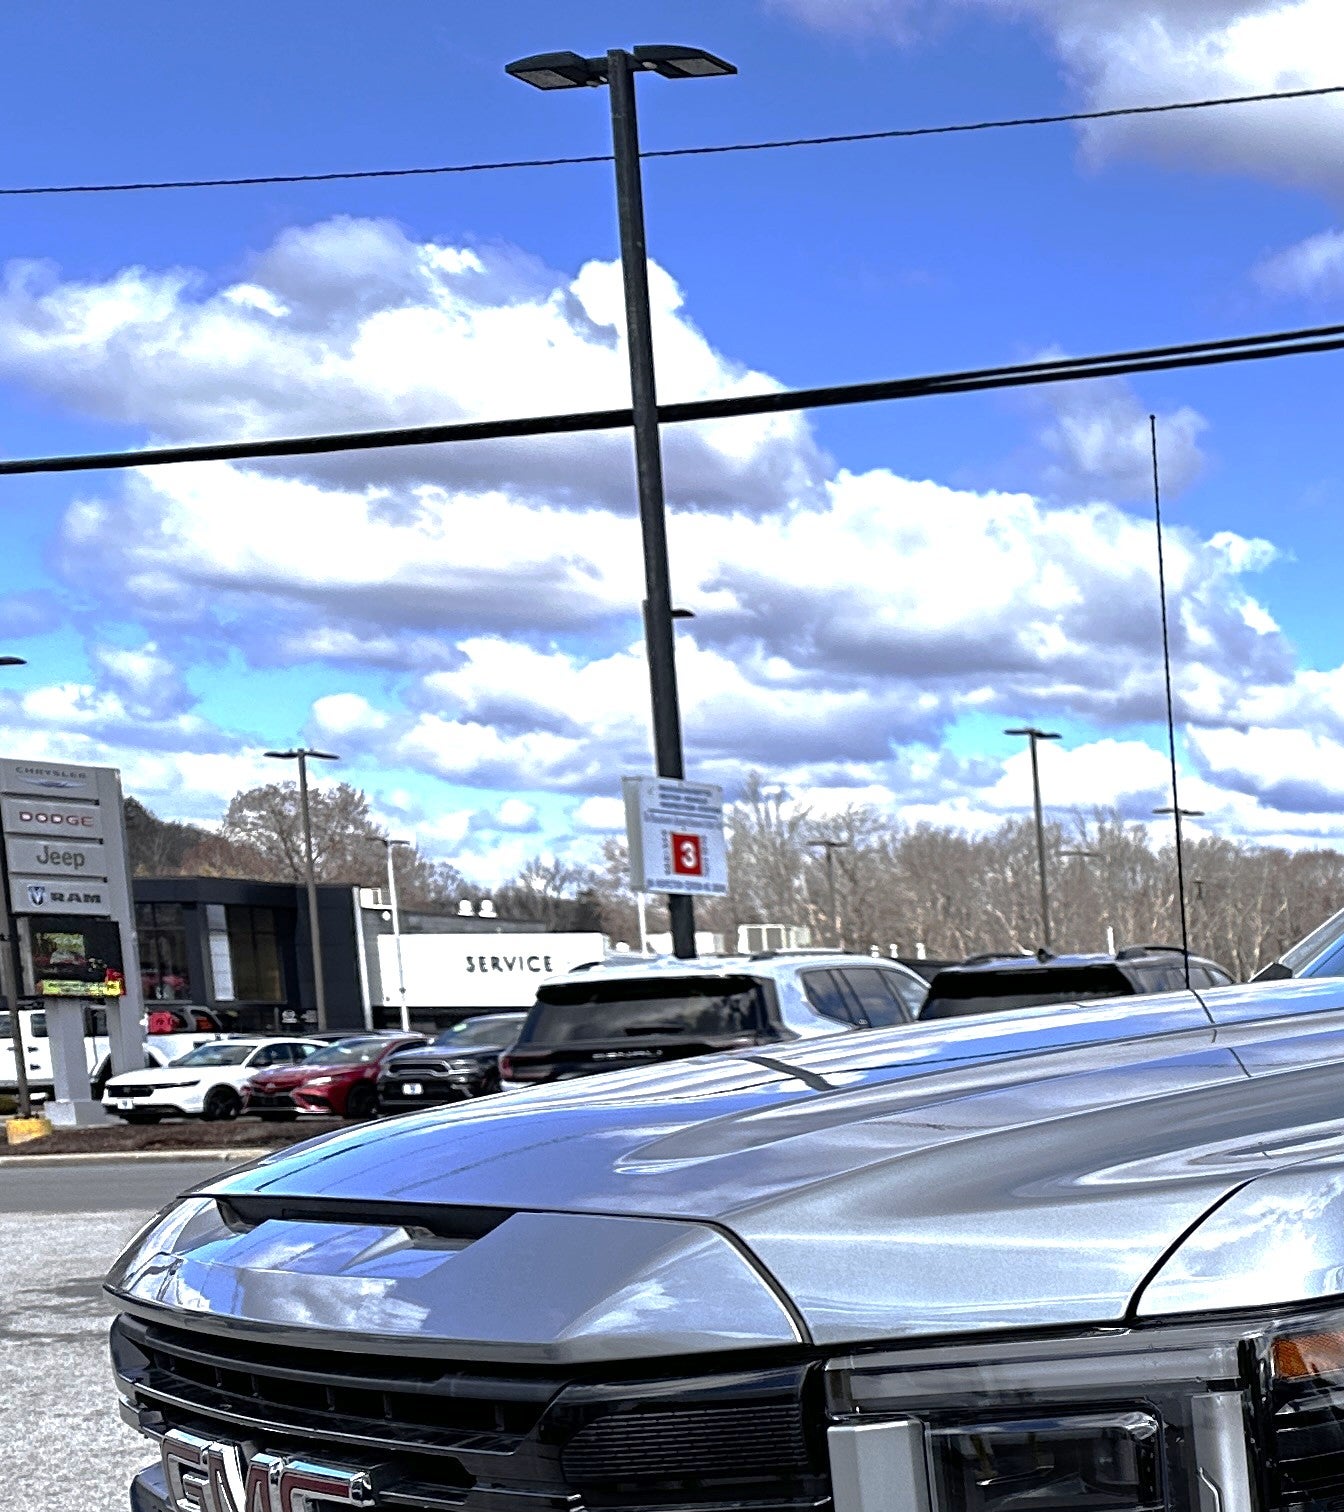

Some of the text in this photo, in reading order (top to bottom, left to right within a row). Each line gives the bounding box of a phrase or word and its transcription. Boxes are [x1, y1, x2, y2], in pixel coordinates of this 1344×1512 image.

[16, 766, 87, 779] CHRYSLER
[19, 811, 95, 828] DODGE
[36, 845, 86, 870] Jeep
[680, 841, 697, 868] 3
[51, 892, 102, 903] RAM
[466, 955, 553, 973] SERVICE
